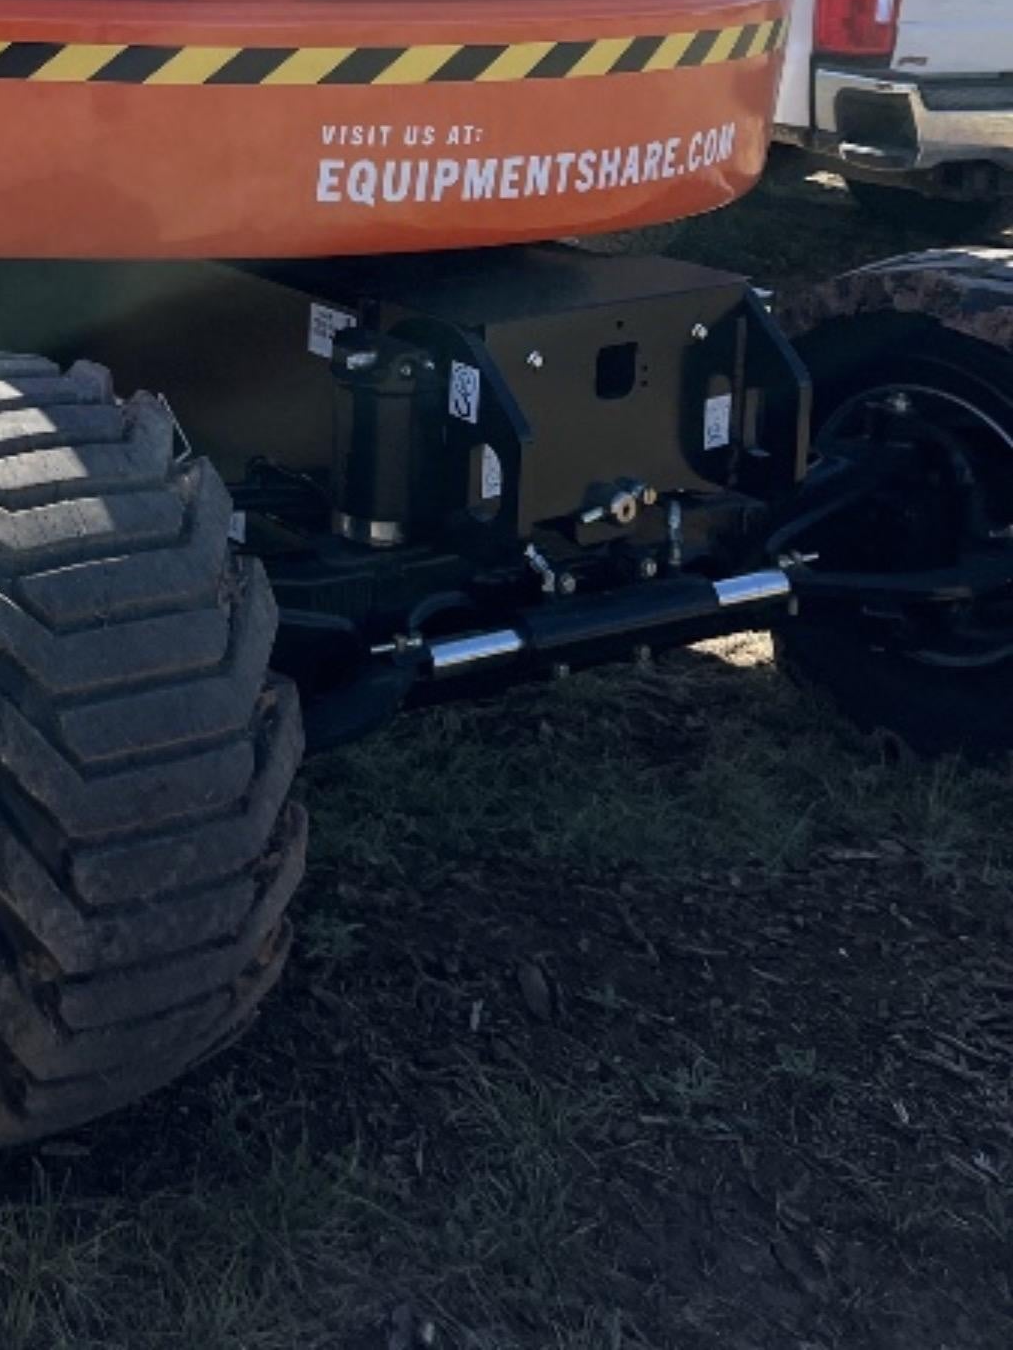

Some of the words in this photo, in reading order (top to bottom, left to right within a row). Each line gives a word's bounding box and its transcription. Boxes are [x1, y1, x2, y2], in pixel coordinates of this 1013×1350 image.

[321, 124, 393, 147] VISIT
[403, 124, 436, 146] US
[316, 121, 737, 207] EQUIPMENTSHARE.COM
